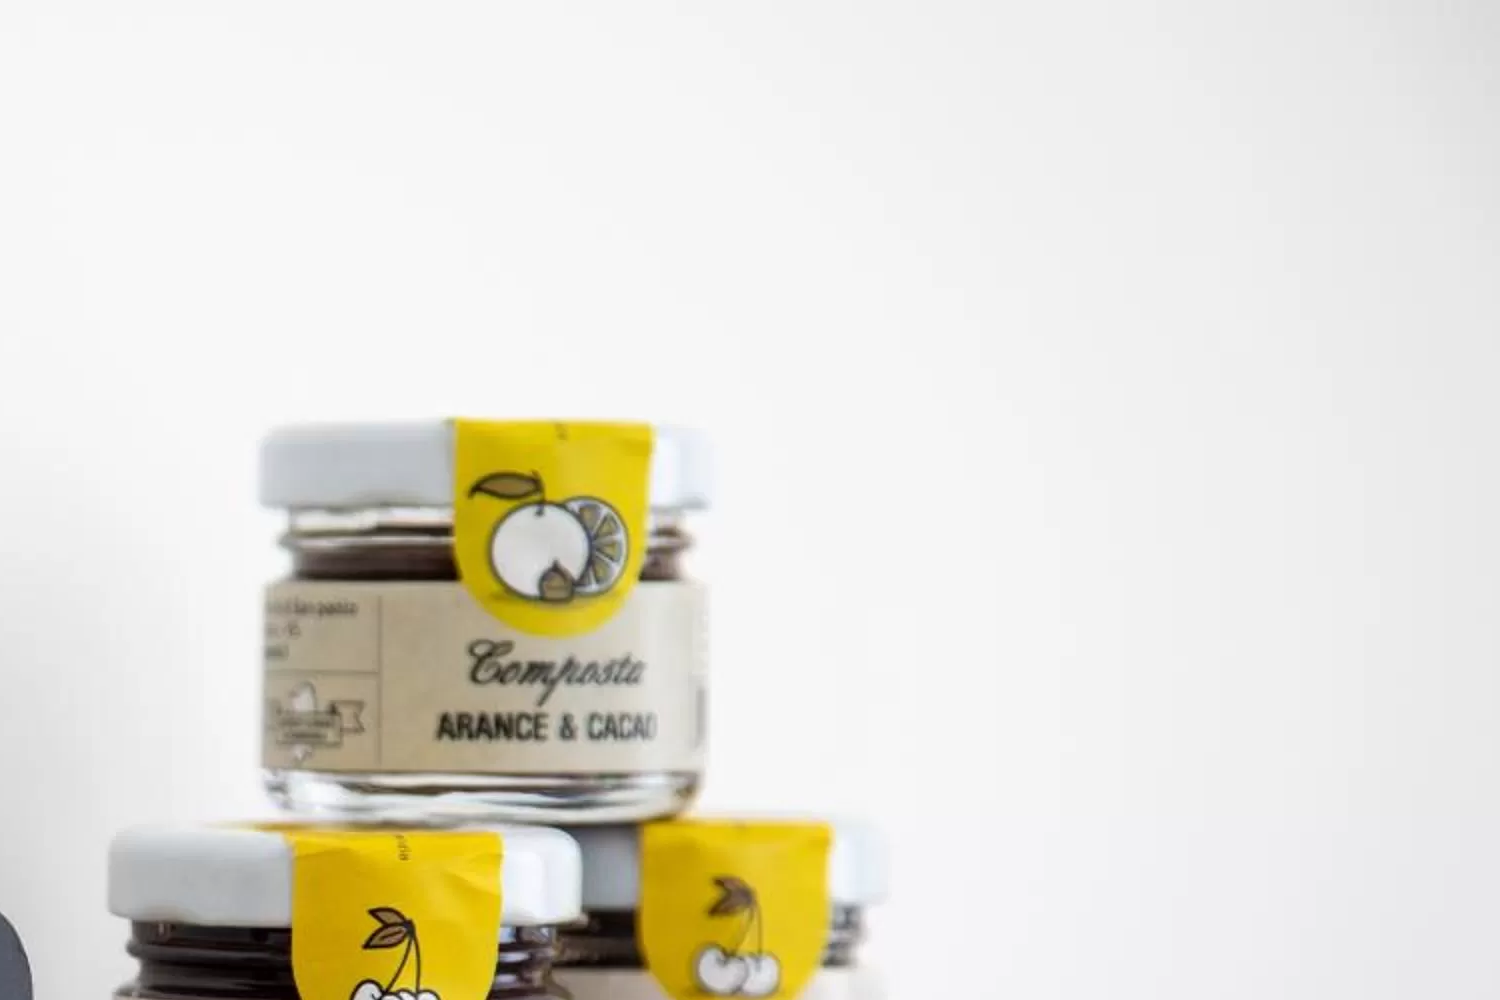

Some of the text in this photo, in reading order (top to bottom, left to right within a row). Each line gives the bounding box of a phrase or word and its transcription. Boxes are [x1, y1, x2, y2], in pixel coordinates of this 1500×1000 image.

[467, 639, 647, 707] Composta
[436, 711, 658, 742] ARANCE & CACAO
